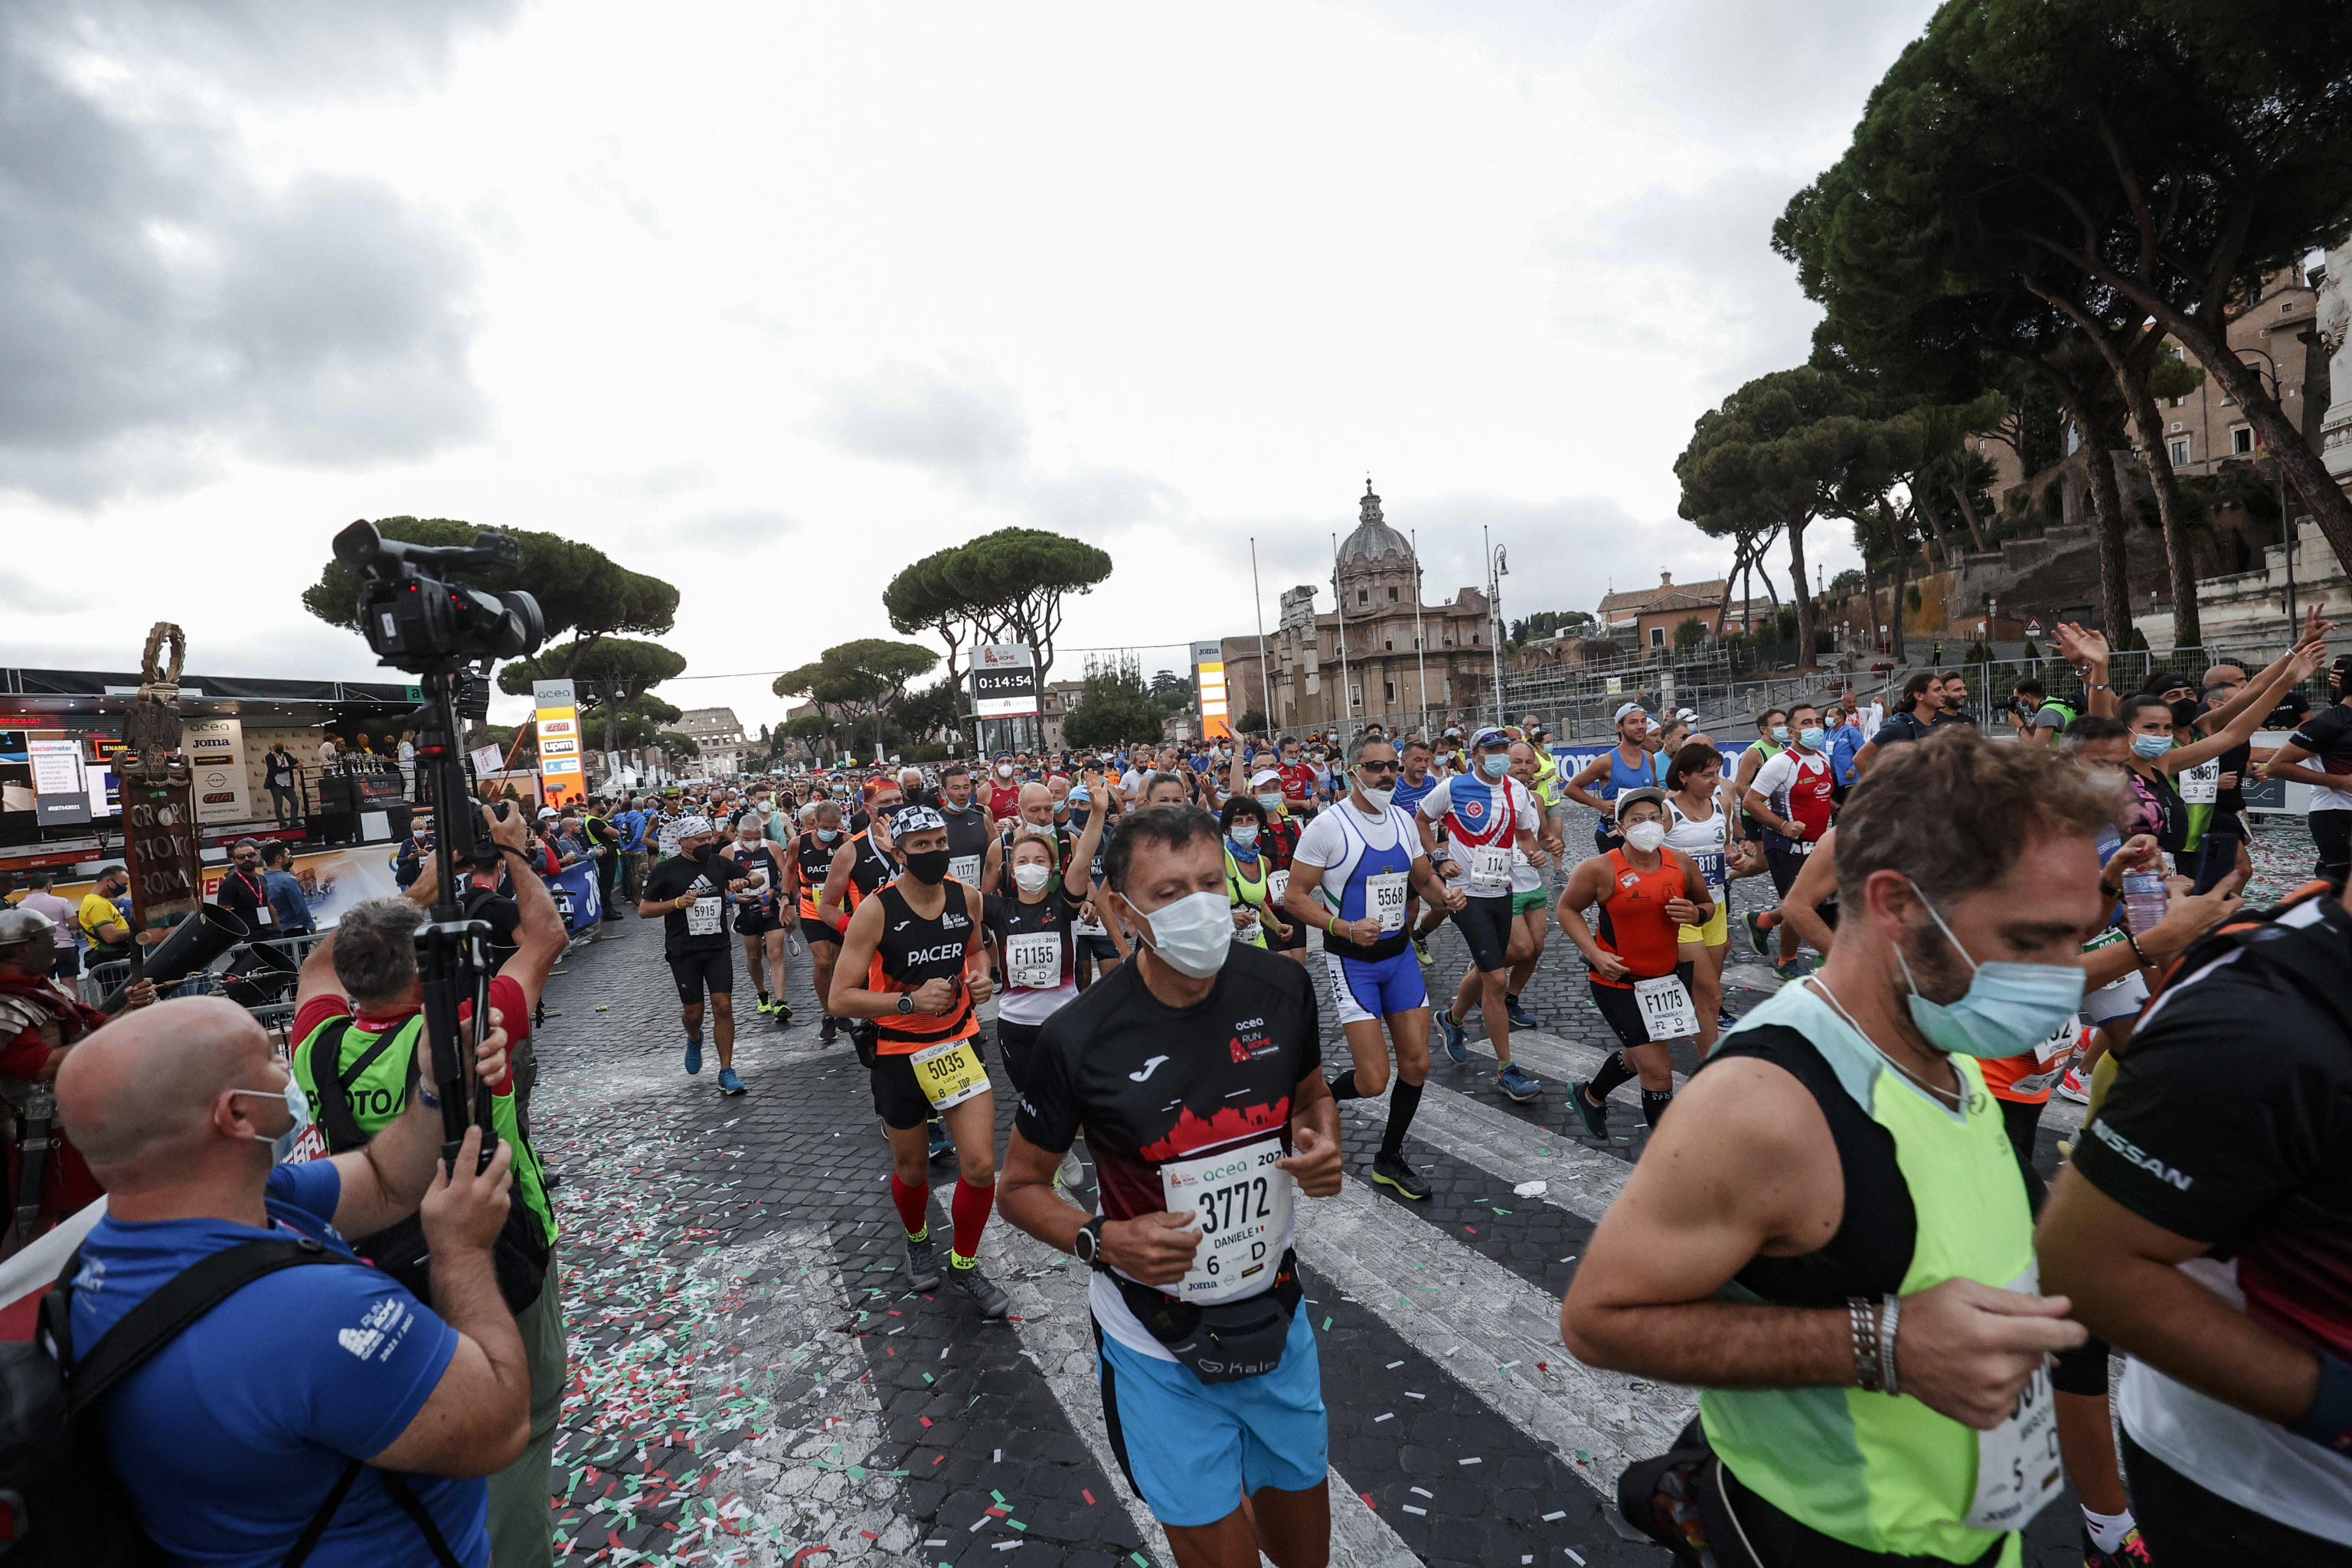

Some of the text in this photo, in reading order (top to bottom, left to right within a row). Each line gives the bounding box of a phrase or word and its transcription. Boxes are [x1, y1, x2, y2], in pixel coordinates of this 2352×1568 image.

[979, 675, 1031, 688] 0:14:54
[538, 690, 570, 698] acea
[191, 723, 229, 731] acea
[193, 738, 230, 748] Joma
[546, 742, 573, 752] upim
[956, 864, 975, 876] 1177
[1488, 857, 1503, 872] 114
[1693, 855, 1717, 871] 818
[1378, 887, 1403, 906] 5568
[694, 906, 715, 917] 5915
[1379, 913, 1400, 923] 8 D
[907, 942, 963, 967] PACER
[1015, 946, 1054, 965] F1155
[1017, 972, 1047, 980] F2 D
[1330, 969, 1344, 1003] ITALIA
[1651, 982, 1669, 991] acea
[1645, 989, 1683, 1014] F1175
[1655, 1011, 1679, 1020] FRANCESCA
[1236, 1017, 1264, 1031] acea
[1655, 1018, 1684, 1031] F2 D
[1242, 1031, 1262, 1044] RUN
[1248, 1037, 1272, 1050] ROME
[927, 1039, 967, 1057] acea 2021
[926, 1051, 965, 1080] 5035
[942, 1074, 956, 1084] LUCA
[938, 1088, 946, 1099] 8
[957, 1076, 970, 1090] TOP
[2091, 1118, 2193, 1191] NISSAN
[1203, 1161, 1247, 1182] acea
[1199, 1177, 1271, 1234] 3772
[1214, 1227, 1254, 1250] DANIELE
[1207, 1256, 1220, 1276] 6
[1251, 1241, 1266, 1262] D
[1187, 1279, 1218, 1292] Joma
[361, 1301, 384, 1328] RUN
[373, 1298, 396, 1329] ROME
[2013, 1457, 2023, 1492] 5
